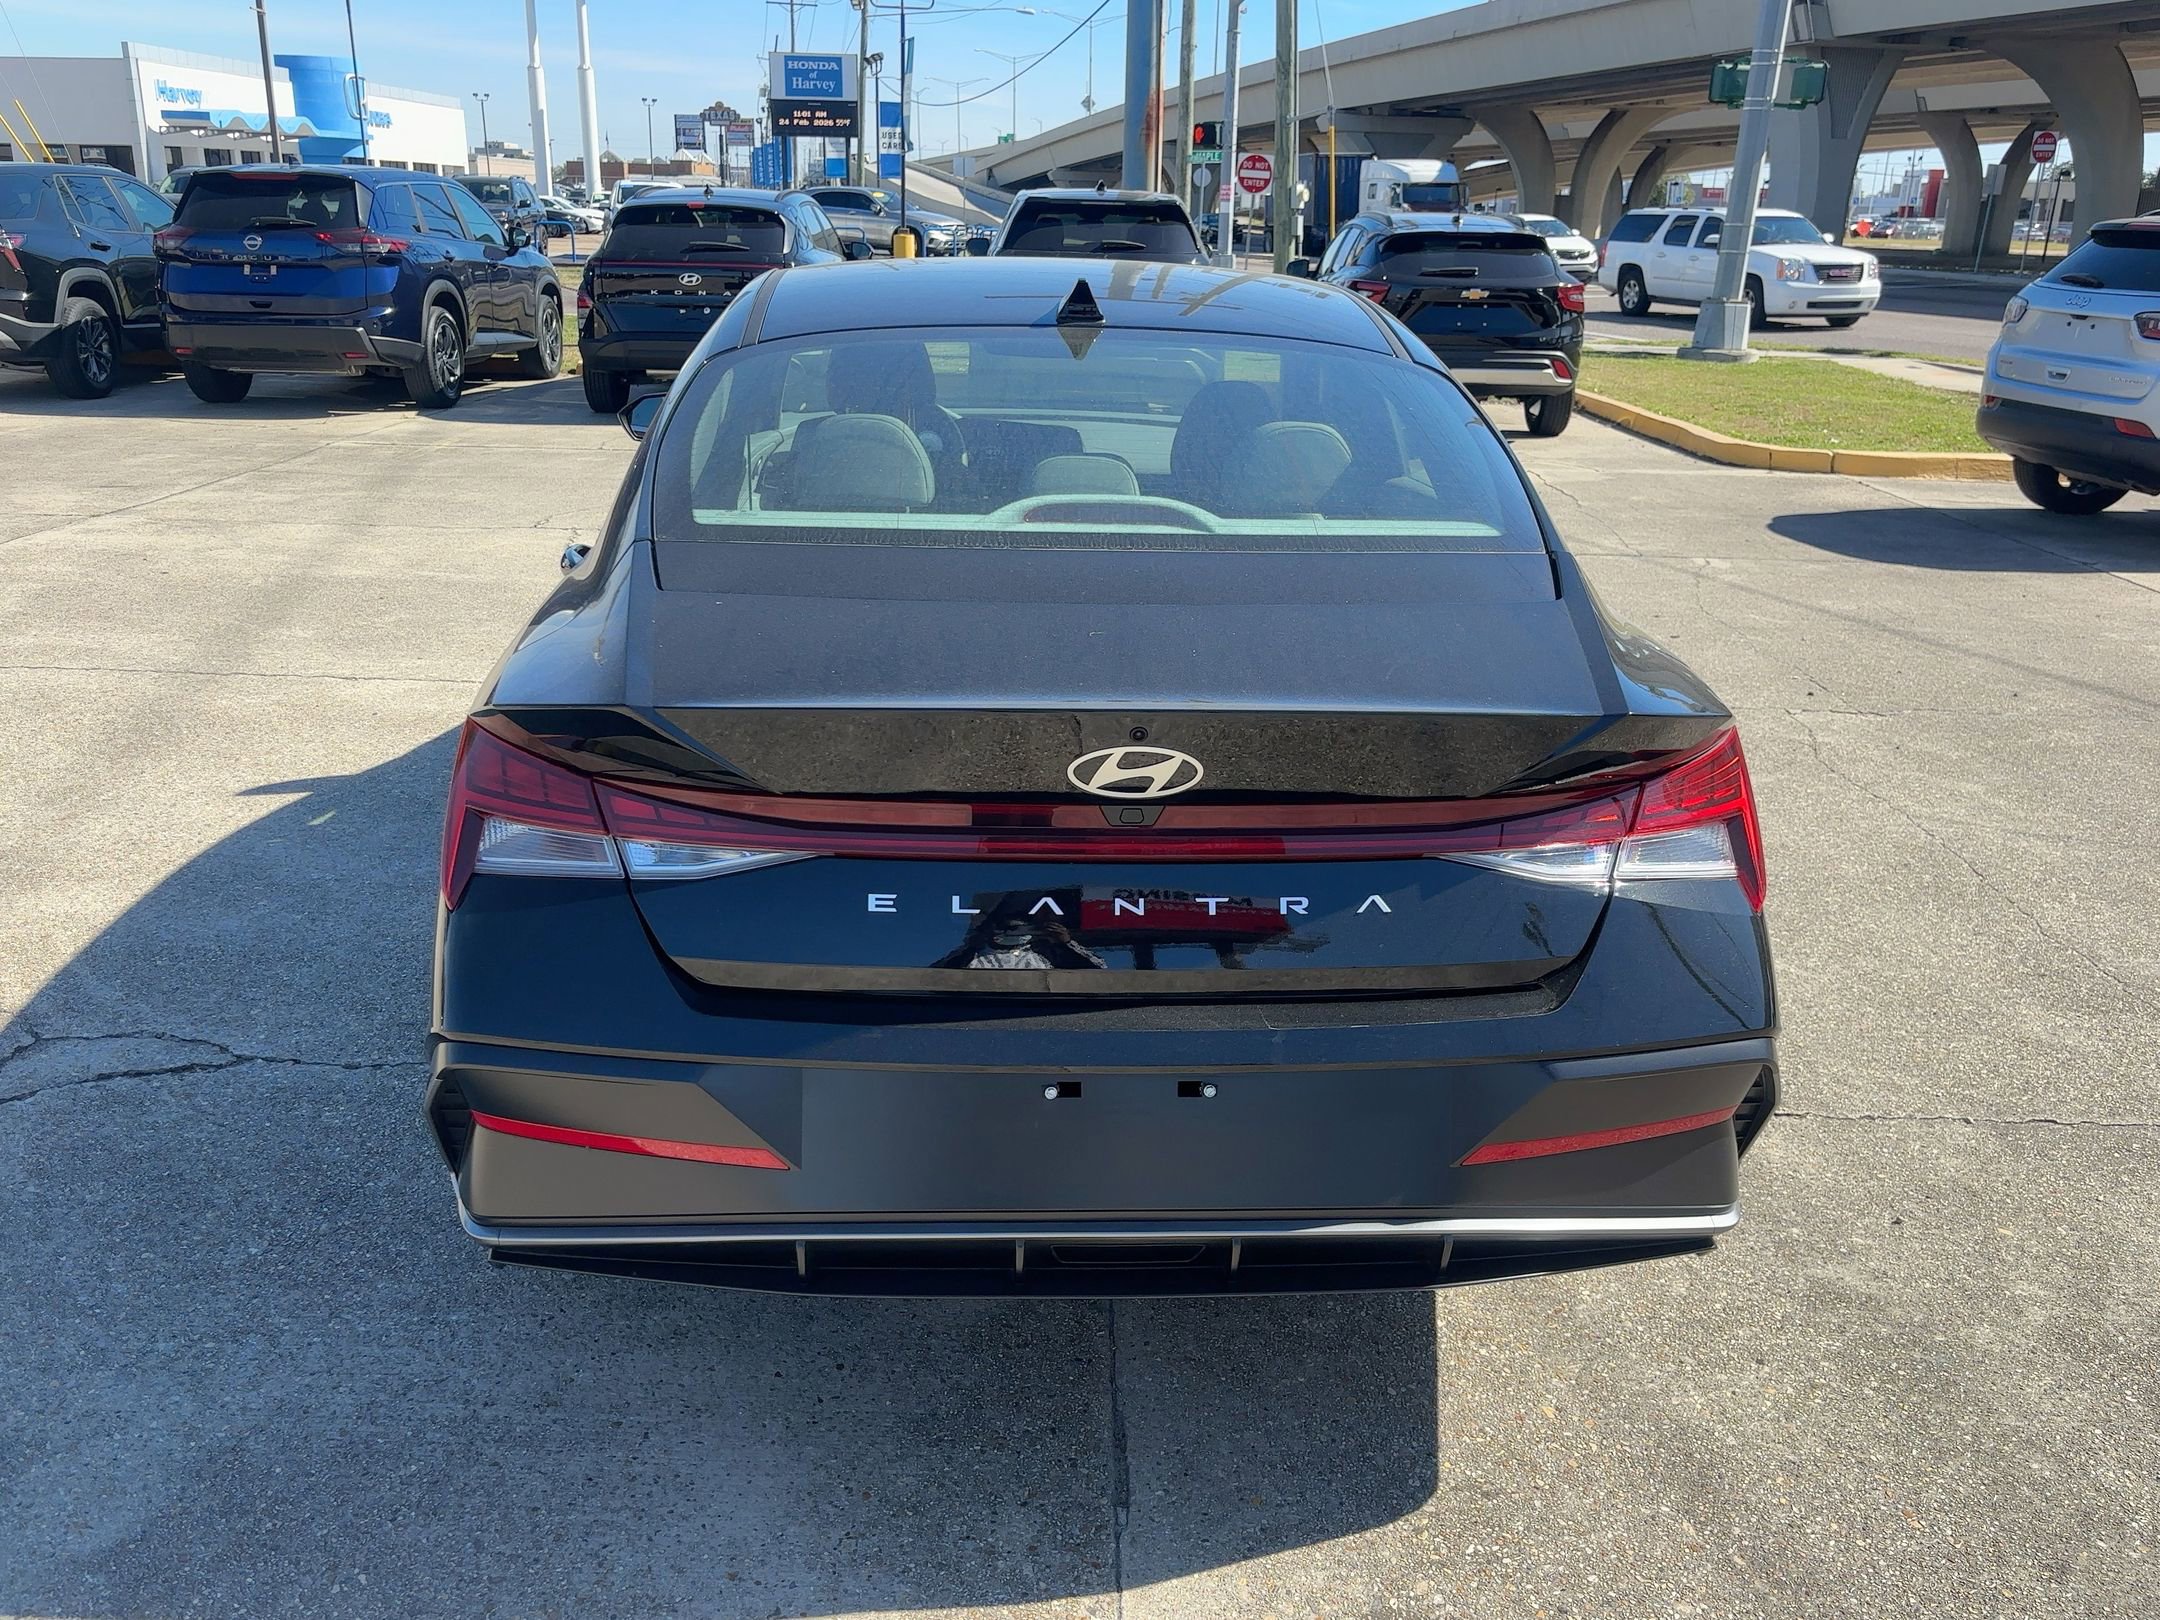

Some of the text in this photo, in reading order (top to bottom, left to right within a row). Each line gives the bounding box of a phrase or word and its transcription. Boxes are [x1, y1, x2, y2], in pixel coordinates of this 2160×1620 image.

[787, 61, 839, 70] HONDA
[809, 71, 818, 79] of
[792, 77, 836, 92] Harvey
[704, 111, 736, 120] TEXAS
[1243, 161, 1253, 169] DO
[1244, 179, 1265, 187] ENTER
[2066, 294, 2091, 308] Jeep
[867, 893, 1392, 916] ELANTRA
